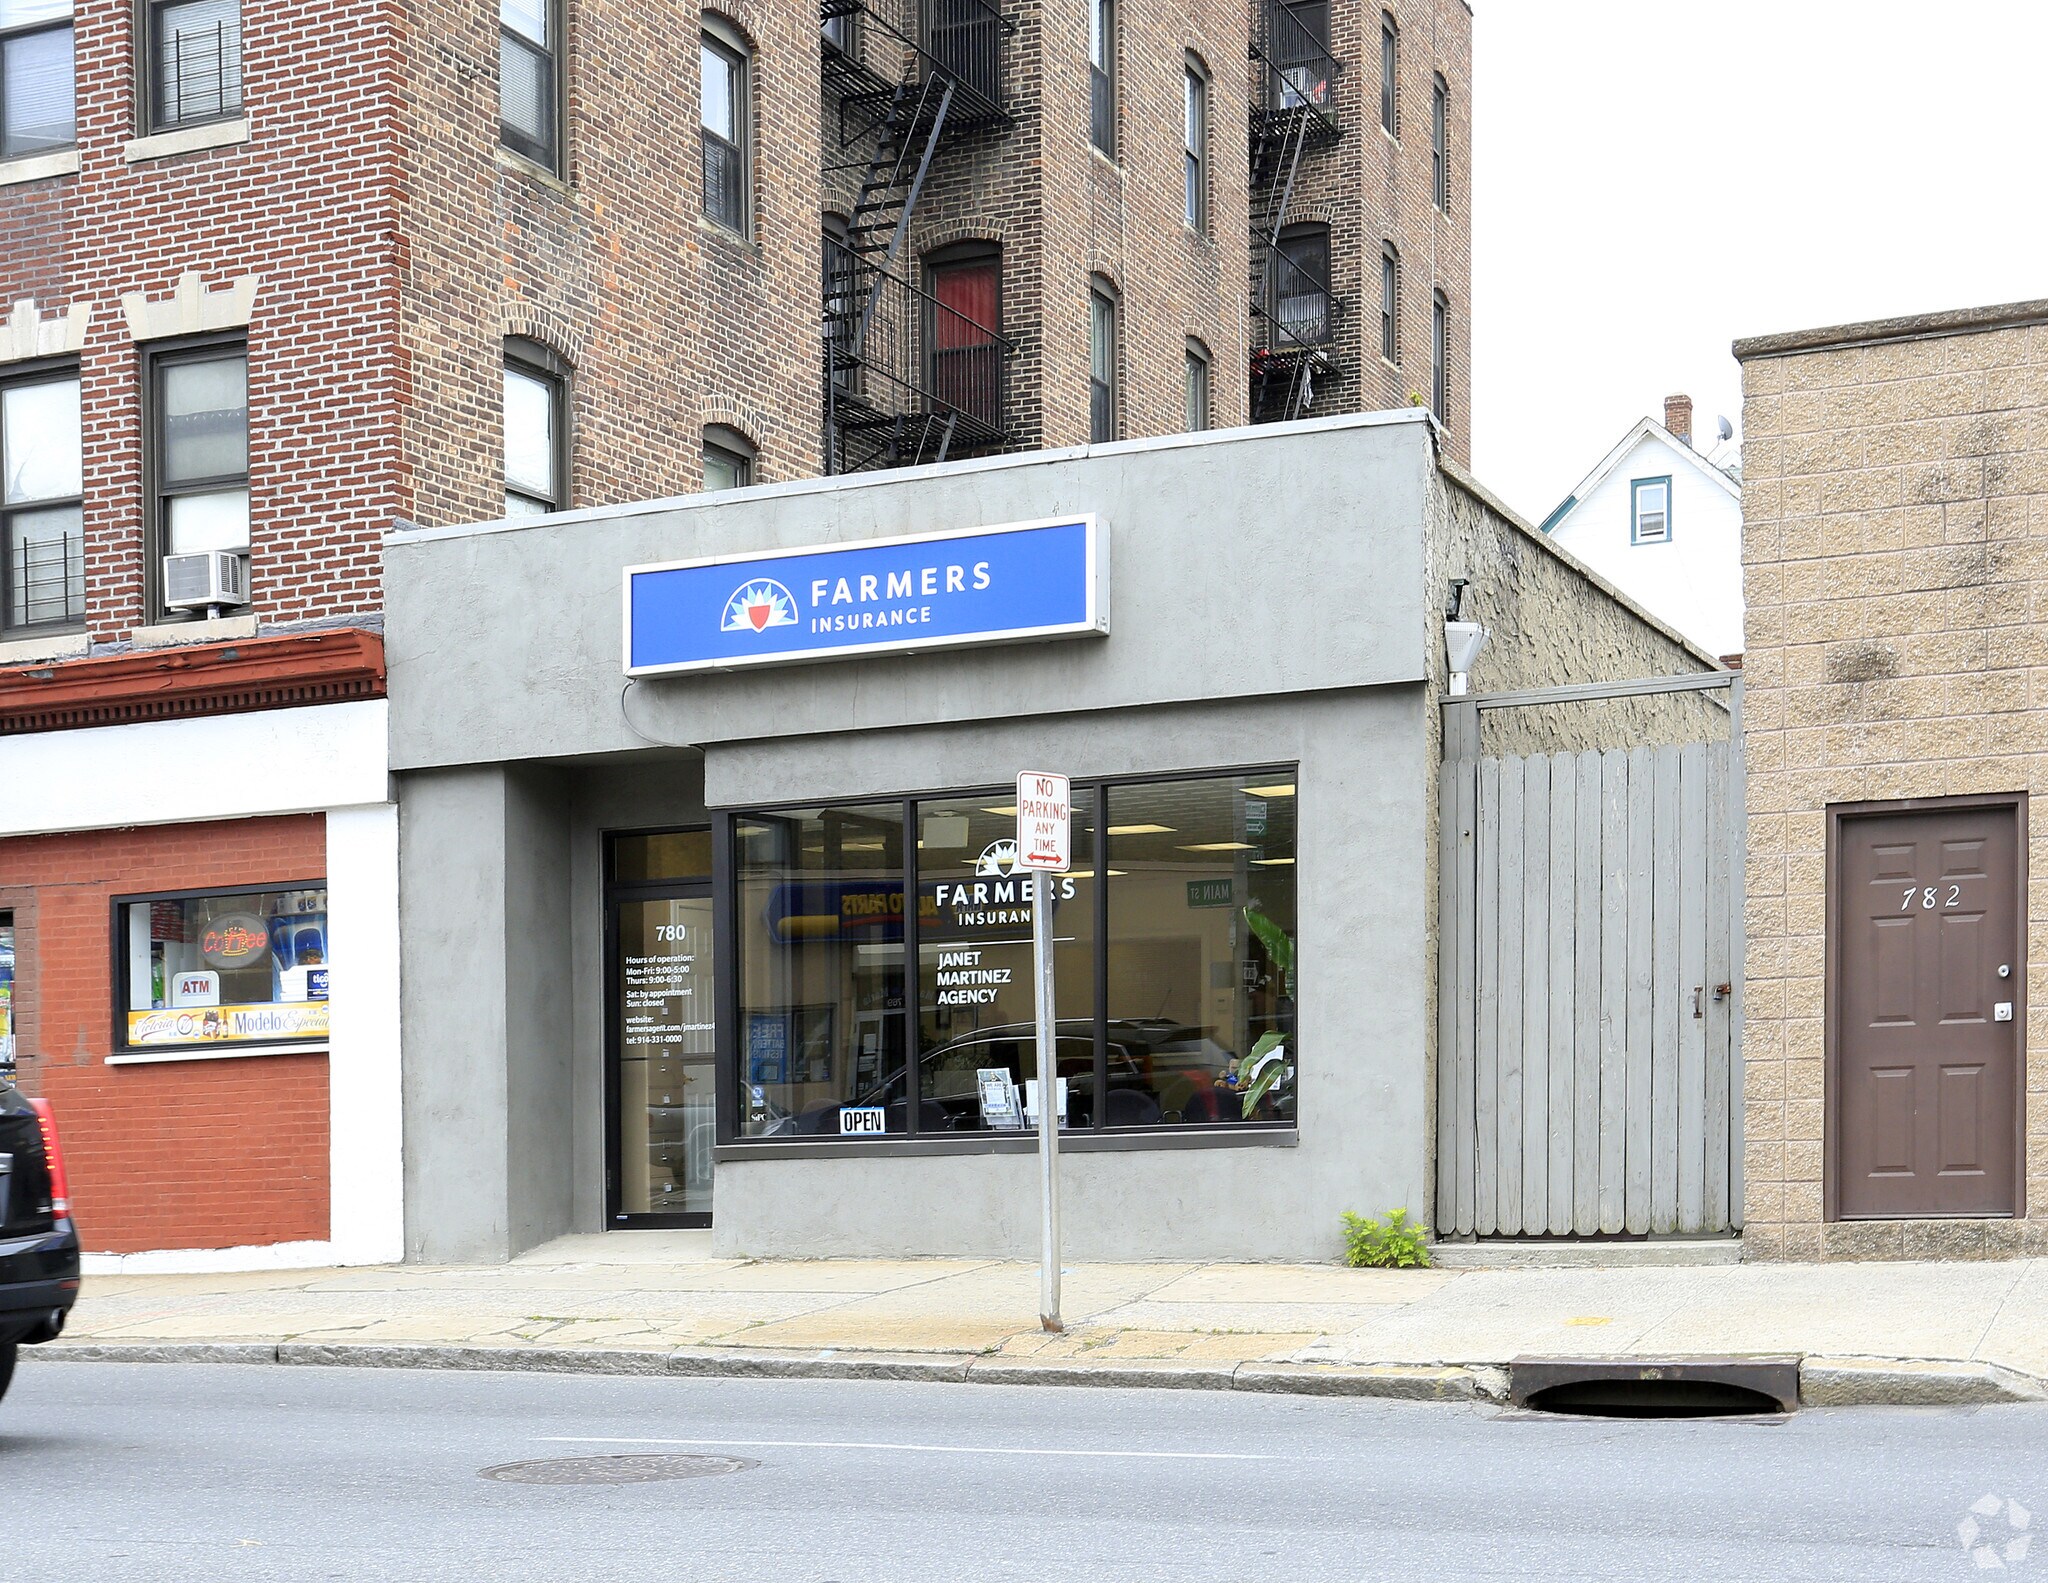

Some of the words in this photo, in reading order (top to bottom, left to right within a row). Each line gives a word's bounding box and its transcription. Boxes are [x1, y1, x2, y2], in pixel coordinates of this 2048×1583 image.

[811, 561, 991, 607] FARMERS
[811, 606, 932, 634] INSURANCE
[1036, 779, 1053, 797] NO
[1022, 800, 1066, 821] PARKING
[1035, 821, 1055, 835] ANY
[1034, 838, 1056, 852] TIME
[1901, 884, 1960, 911] 782
[958, 909, 1030, 926] INSURAN
[203, 930, 268, 953] Coffee
[655, 924, 686, 942] 780
[626, 956, 647, 965] Hours
[648, 954, 656, 963] of
[657, 953, 695, 964] operation:
[937, 951, 982, 970] JANET
[626, 966, 655, 976] Mon-Fri:
[655, 965, 690, 974] 9:00-5:00
[937, 968, 1012, 986] MARTINEZ
[182, 980, 210, 994] ATM
[626, 976, 648, 985] Thurs:
[648, 975, 683, 984] 9:00-6:30
[626, 990, 639, 999] Sat:
[640, 990, 647, 999] by
[648, 988, 693, 998] appointment
[937, 988, 998, 1005] AGENCY
[626, 1000, 641, 1008] Sun:
[642, 999, 665, 1007] closed
[234, 1011, 281, 1034] Modelo
[626, 1015, 655, 1024] website:
[626, 1036, 637, 1045] tel:
[637, 1035, 683, 1044] 914-331-0000
[844, 1111, 881, 1131] OPEN
